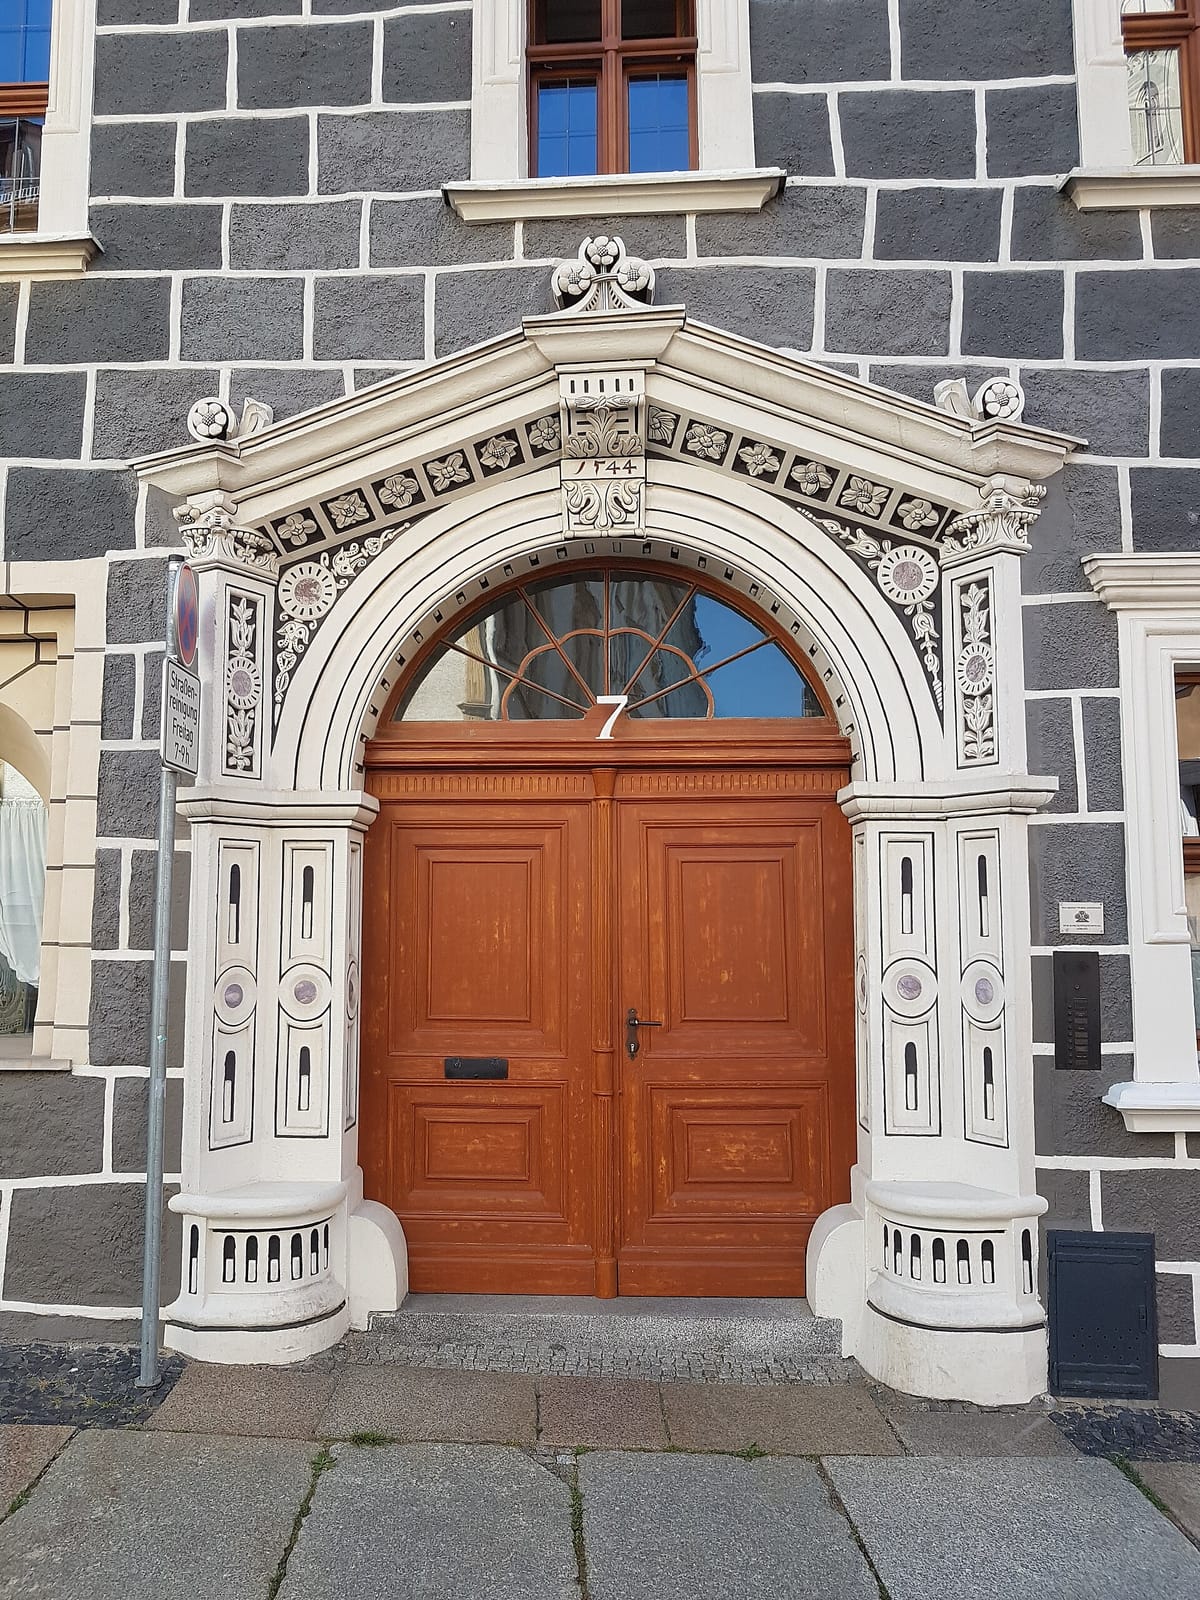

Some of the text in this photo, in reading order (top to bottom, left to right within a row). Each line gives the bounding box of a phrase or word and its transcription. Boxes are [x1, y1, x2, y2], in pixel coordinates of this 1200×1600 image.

[574, 459, 637, 476] 1544
[171, 670, 197, 699] Straßen-
[169, 694, 197, 725] reinigung
[595, 695, 628, 740] 7
[172, 717, 194, 747] Freitag
